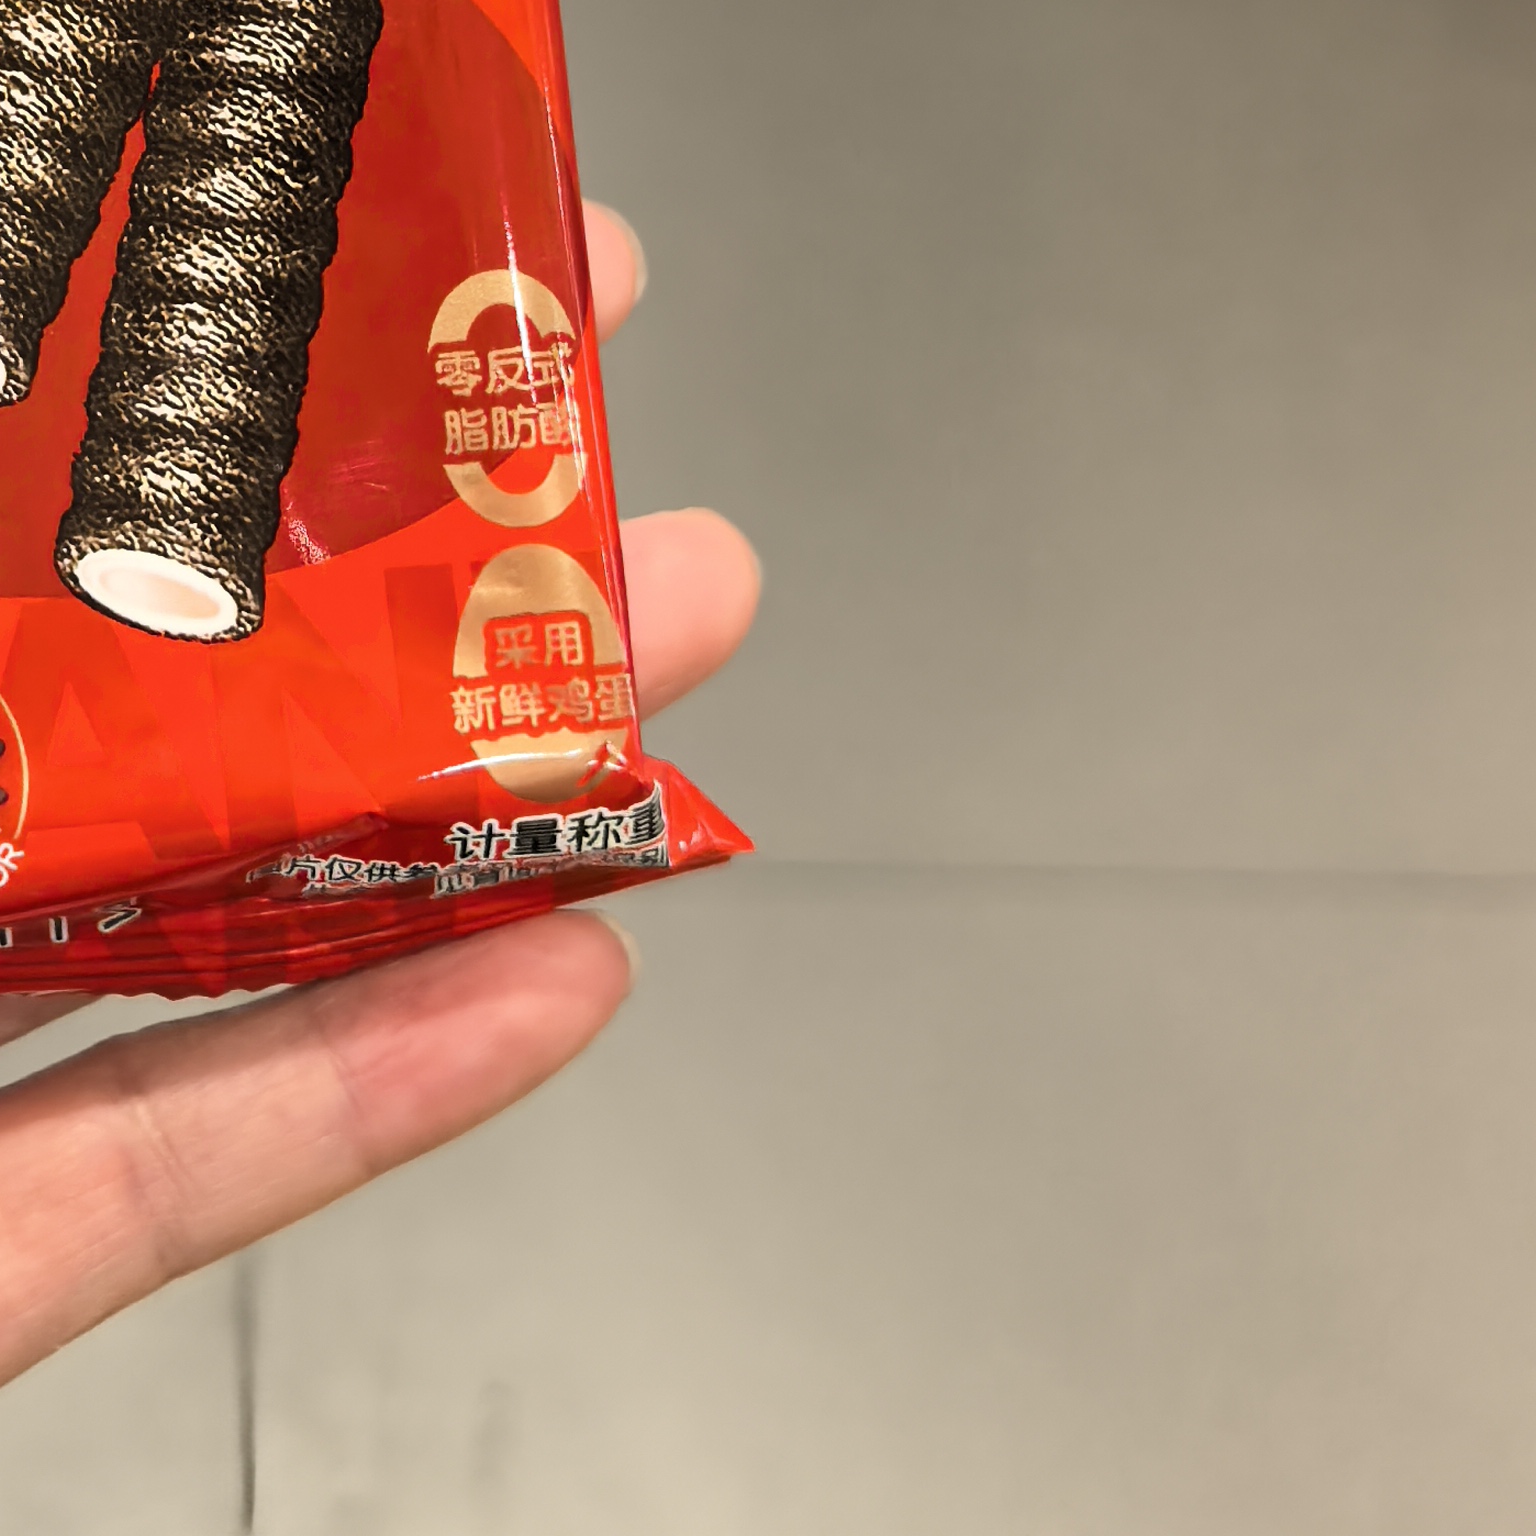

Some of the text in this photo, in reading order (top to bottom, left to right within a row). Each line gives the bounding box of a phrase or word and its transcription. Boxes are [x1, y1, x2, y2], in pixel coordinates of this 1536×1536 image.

[435, 341, 574, 396] 零反式
[495, 621, 584, 669] 采用
[450, 673, 633, 733] 新鲜鸡蛋
